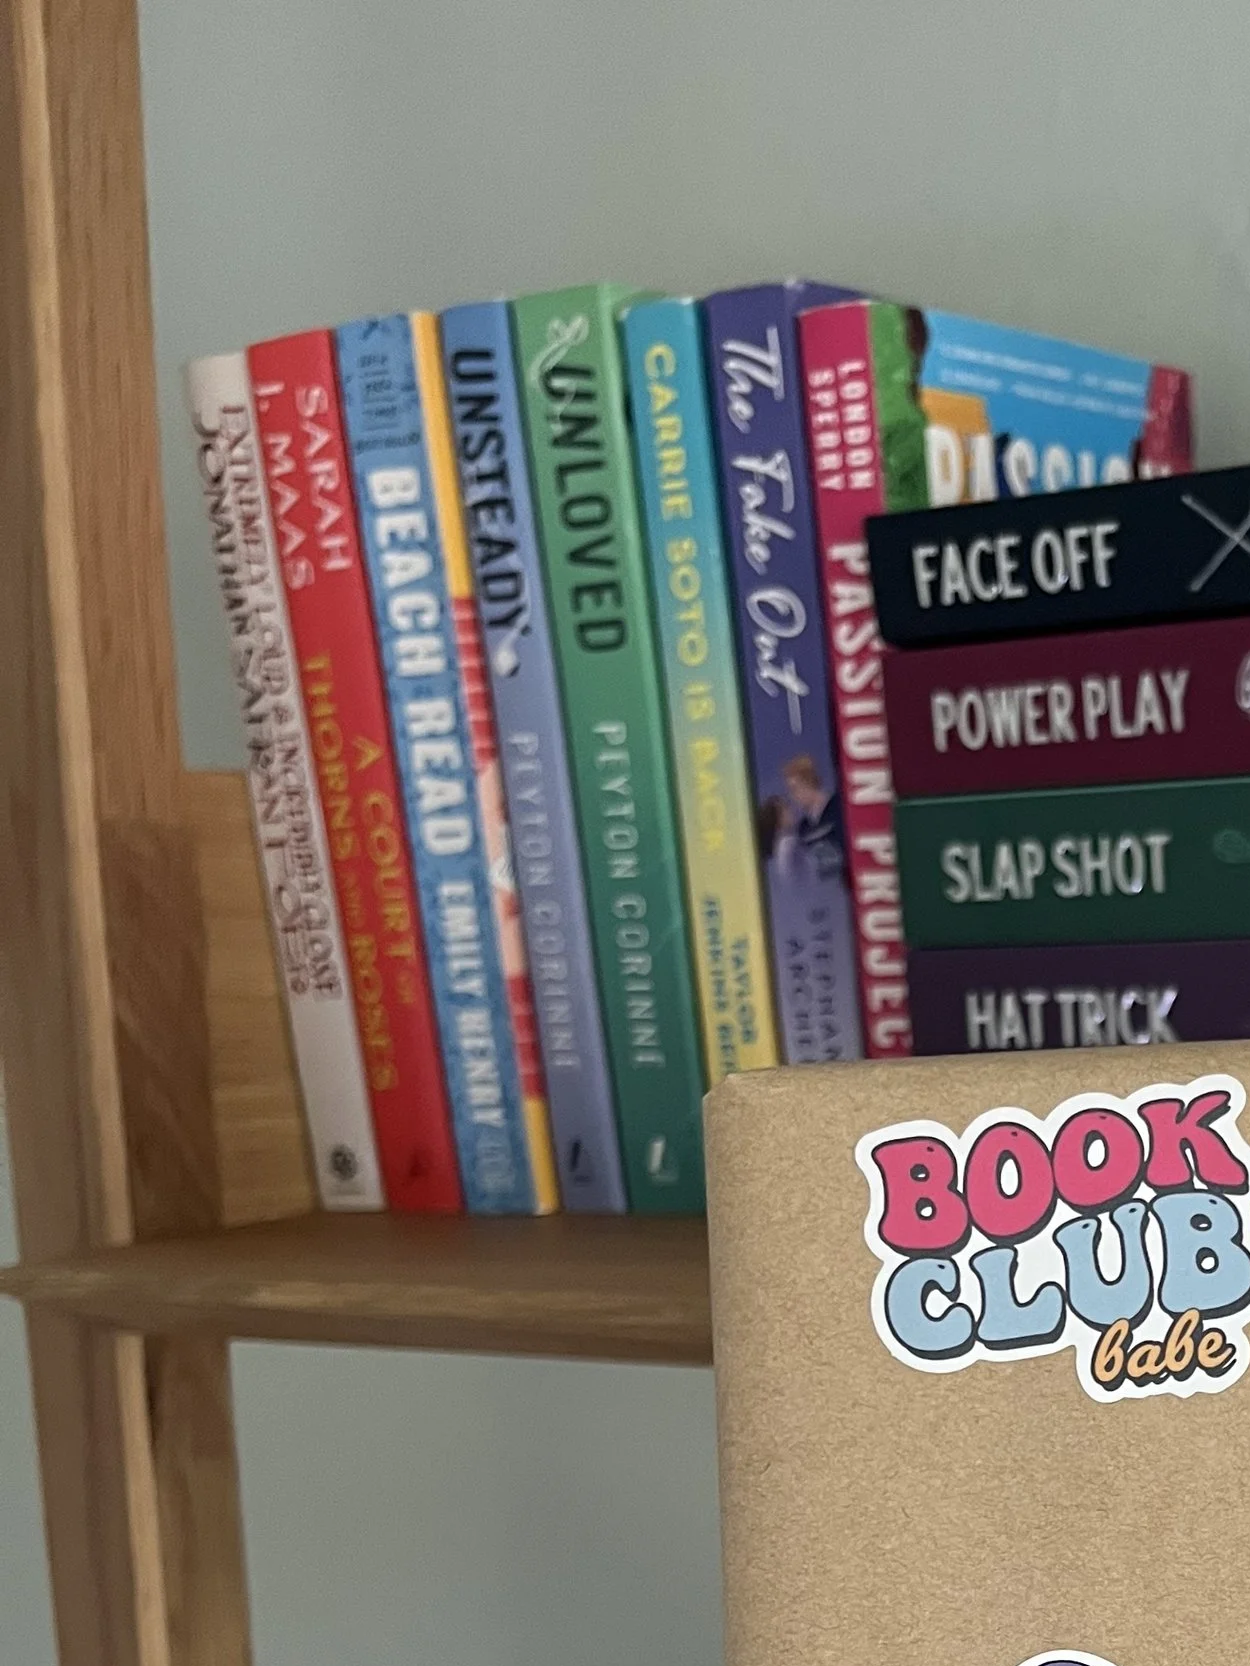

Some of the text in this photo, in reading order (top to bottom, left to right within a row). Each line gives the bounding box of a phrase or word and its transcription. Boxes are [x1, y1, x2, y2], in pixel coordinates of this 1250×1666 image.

[298, 386, 349, 571] SARAH
[450, 347, 527, 637] UNSTEADY
[810, 372, 842, 489] SPERRY
[840, 364, 873, 487] LONDON
[266, 431, 311, 586] MAAS
[368, 466, 449, 677] BEACH
[543, 364, 628, 654] UNLOVED
[721, 329, 815, 735] The Fake Out
[912, 522, 1118, 608] FACE OFF
[646, 345, 726, 850] CARRIE SOTO IS BACK
[829, 545, 887, 804] PASSION
[353, 732, 380, 771] A
[404, 695, 475, 853] READ
[931, 668, 1190, 753] POWER PLAY
[306, 655, 356, 855] THORNS
[349, 929, 394, 1090] ROSES
[366, 792, 413, 963] COURT
[435, 880, 487, 993] EMILY
[510, 735, 577, 1067] PEYTON CORINNE
[591, 719, 663, 1066] PEYTON CORINNE
[941, 833, 1172, 903] SLAP SHOT
[456, 1009, 506, 1130] HENRY
[965, 987, 1180, 1049] HAT TRICK
[872, 1090, 1249, 1258] BOOK
[1091, 1308, 1237, 1391] babe
